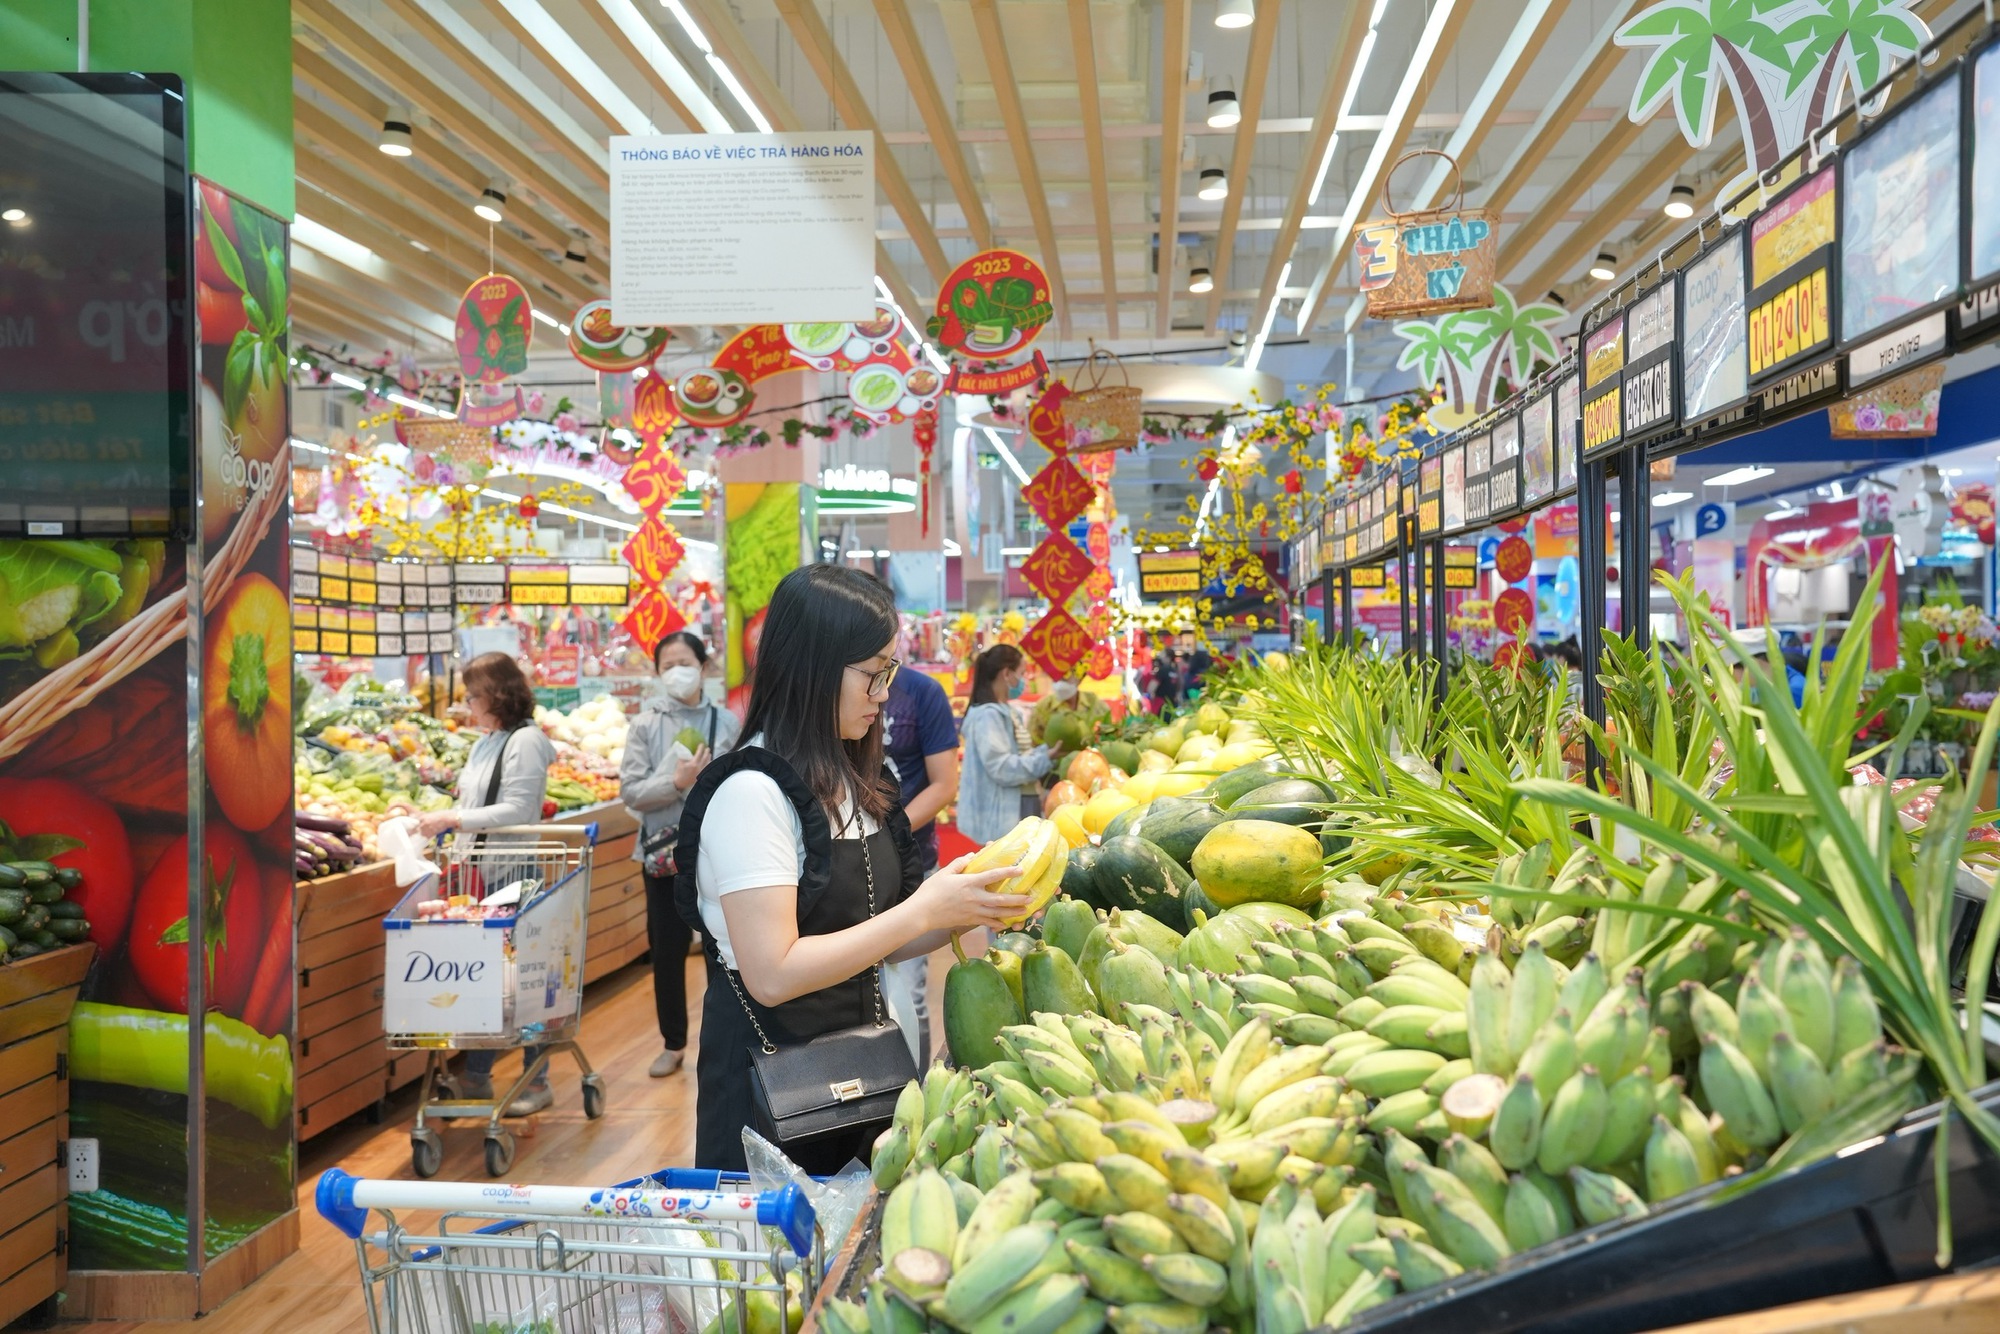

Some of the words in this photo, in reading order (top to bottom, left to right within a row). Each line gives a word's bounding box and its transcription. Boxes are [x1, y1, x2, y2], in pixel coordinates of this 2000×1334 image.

[621, 149, 669, 162] THÔNG
[672, 146, 700, 161] BÁO
[704, 145, 722, 160] VỀ
[725, 146, 756, 161] VIỆC
[791, 144, 830, 159] HÀNG
[833, 143, 864, 158] HÓA
[972, 257, 1011, 277] 2023
[1355, 226, 1398, 290] 3
[1402, 218, 1489, 256] THẬP
[480, 283, 508, 300] 2023
[1426, 261, 1467, 299] KỶ
[1752, 289, 1810, 362] 11.200
[220, 453, 274, 500] co.op
[1703, 511, 1719, 529] 2
[403, 950, 485, 983] Dove
[482, 1187, 513, 1199] co.op
